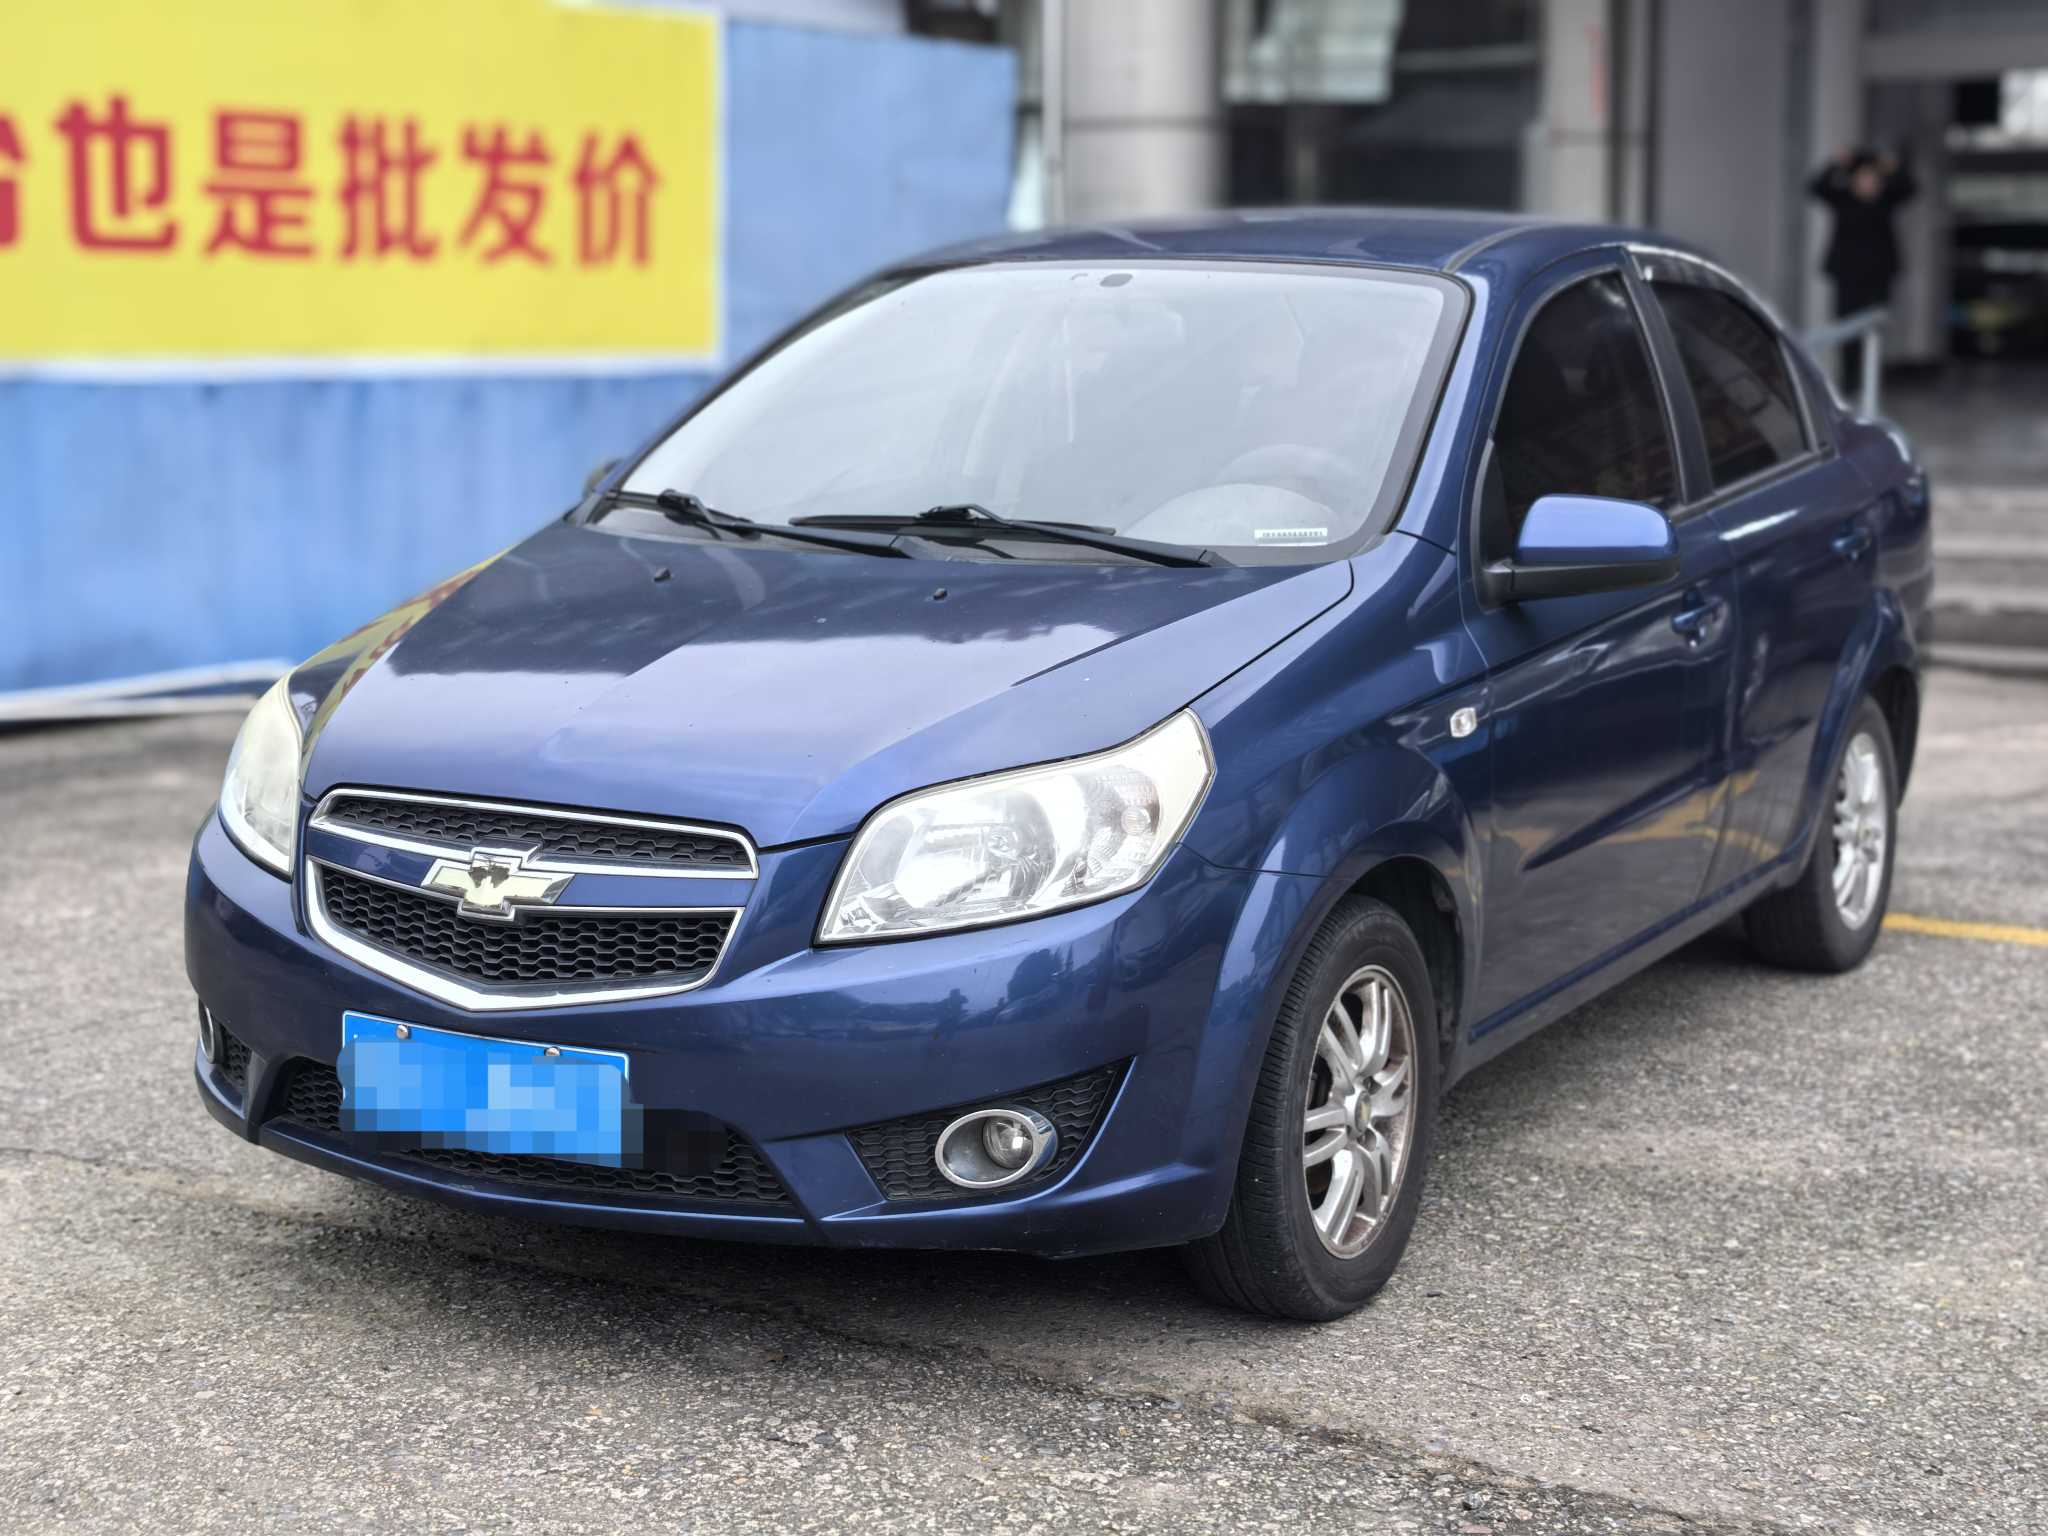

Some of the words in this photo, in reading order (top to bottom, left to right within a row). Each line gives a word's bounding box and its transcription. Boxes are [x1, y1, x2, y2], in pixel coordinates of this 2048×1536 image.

[0, 97, 661, 266] 也是批发价
